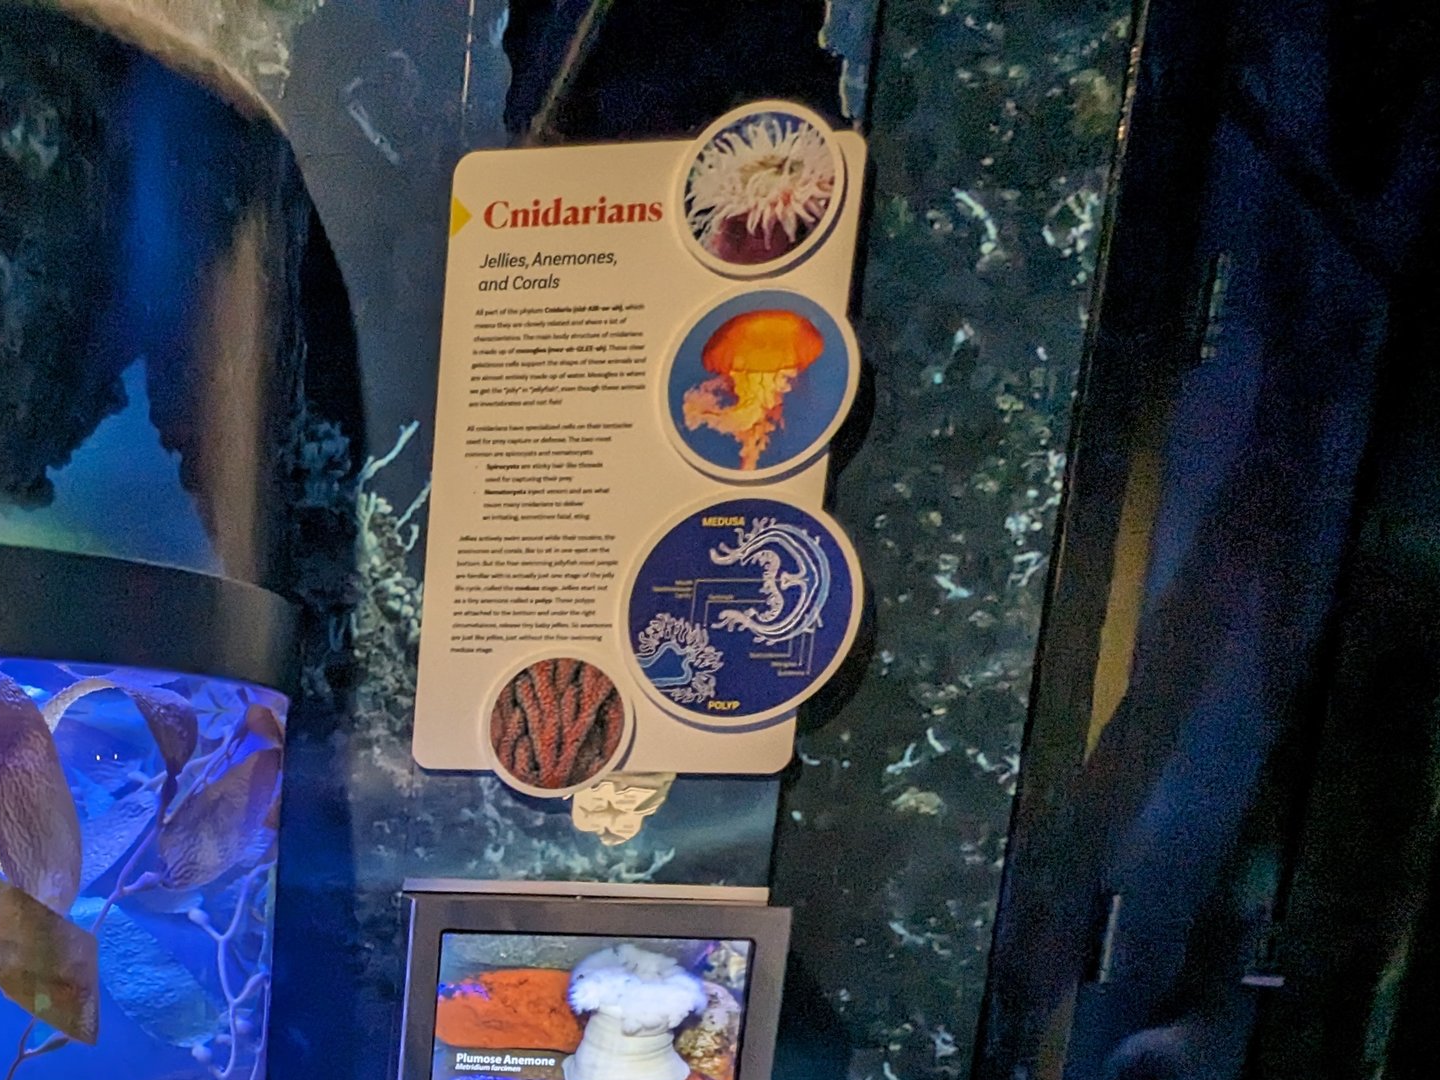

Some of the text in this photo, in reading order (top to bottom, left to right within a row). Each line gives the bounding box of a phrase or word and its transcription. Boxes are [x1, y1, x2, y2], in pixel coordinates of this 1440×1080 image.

[483, 196, 663, 229] Cnidarians
[479, 251, 618, 269] Jellies, Anemones,
[478, 273, 560, 291] and Corals
[702, 516, 745, 527] MEDUSA
[708, 700, 740, 711] POLYP
[456, 1053, 555, 1066] Plumose Anemone
